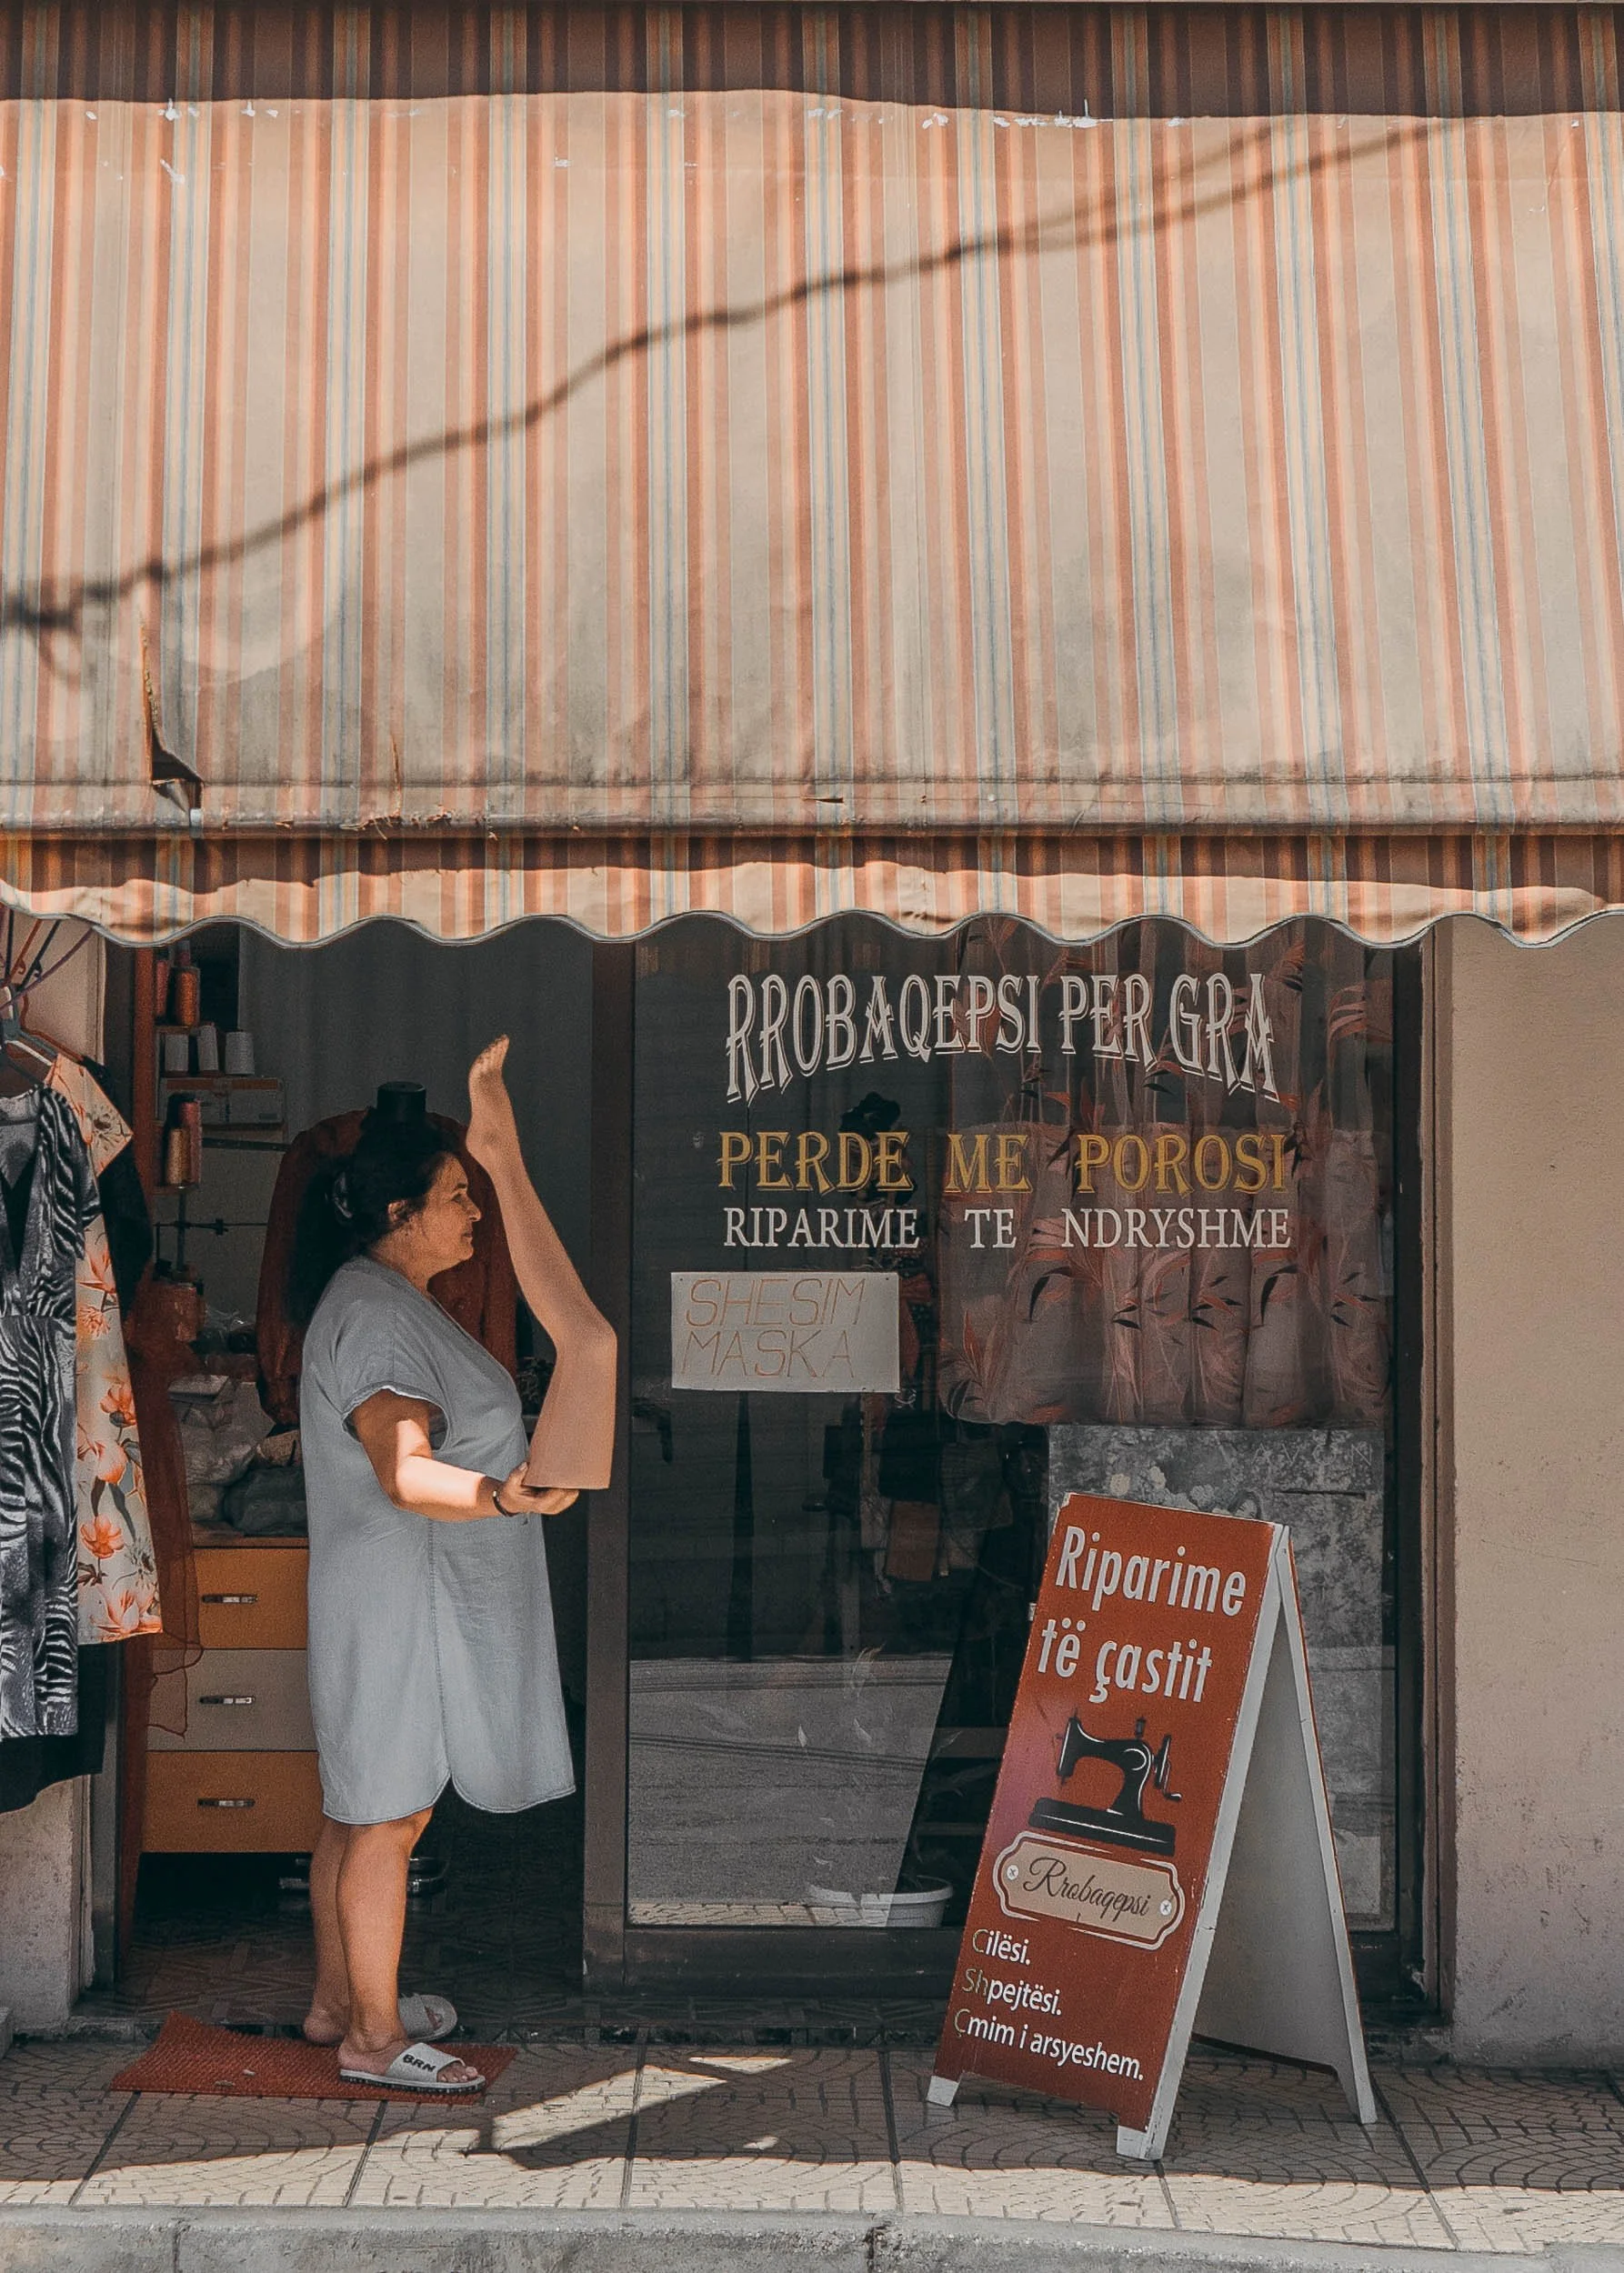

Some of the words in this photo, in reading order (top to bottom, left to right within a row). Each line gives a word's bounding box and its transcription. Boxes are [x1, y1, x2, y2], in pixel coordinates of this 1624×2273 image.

[725, 974, 1042, 1107] RROBAQEPSI
[1058, 973, 1158, 1073] PER
[1169, 972, 1281, 1104] GRA
[716, 1131, 916, 1197] PERDE
[944, 1133, 1033, 1195] ME
[1075, 1133, 1291, 1198] POROSI
[723, 1207, 920, 1249] RIPARIME
[964, 1207, 1018, 1249] TE
[1060, 1207, 1291, 1249] NDRYSHME
[686, 1277, 866, 1327] SHESIM
[681, 1329, 855, 1378] MASKA
[1055, 1525, 1247, 1617] Riparime
[1038, 1617, 1087, 1678] të
[1088, 1637, 1213, 1704] çastit
[1022, 1856, 1153, 1923] Rrobaqepsi
[972, 1928, 1031, 1966] Cilësi.
[961, 1968, 1062, 2016] Shpejtësi.
[403, 2053, 436, 2073] BRN
[954, 2008, 1016, 2047] Çmim
[1019, 2024, 1029, 2049] i
[1029, 2032, 1145, 2081] arsyeshem.
